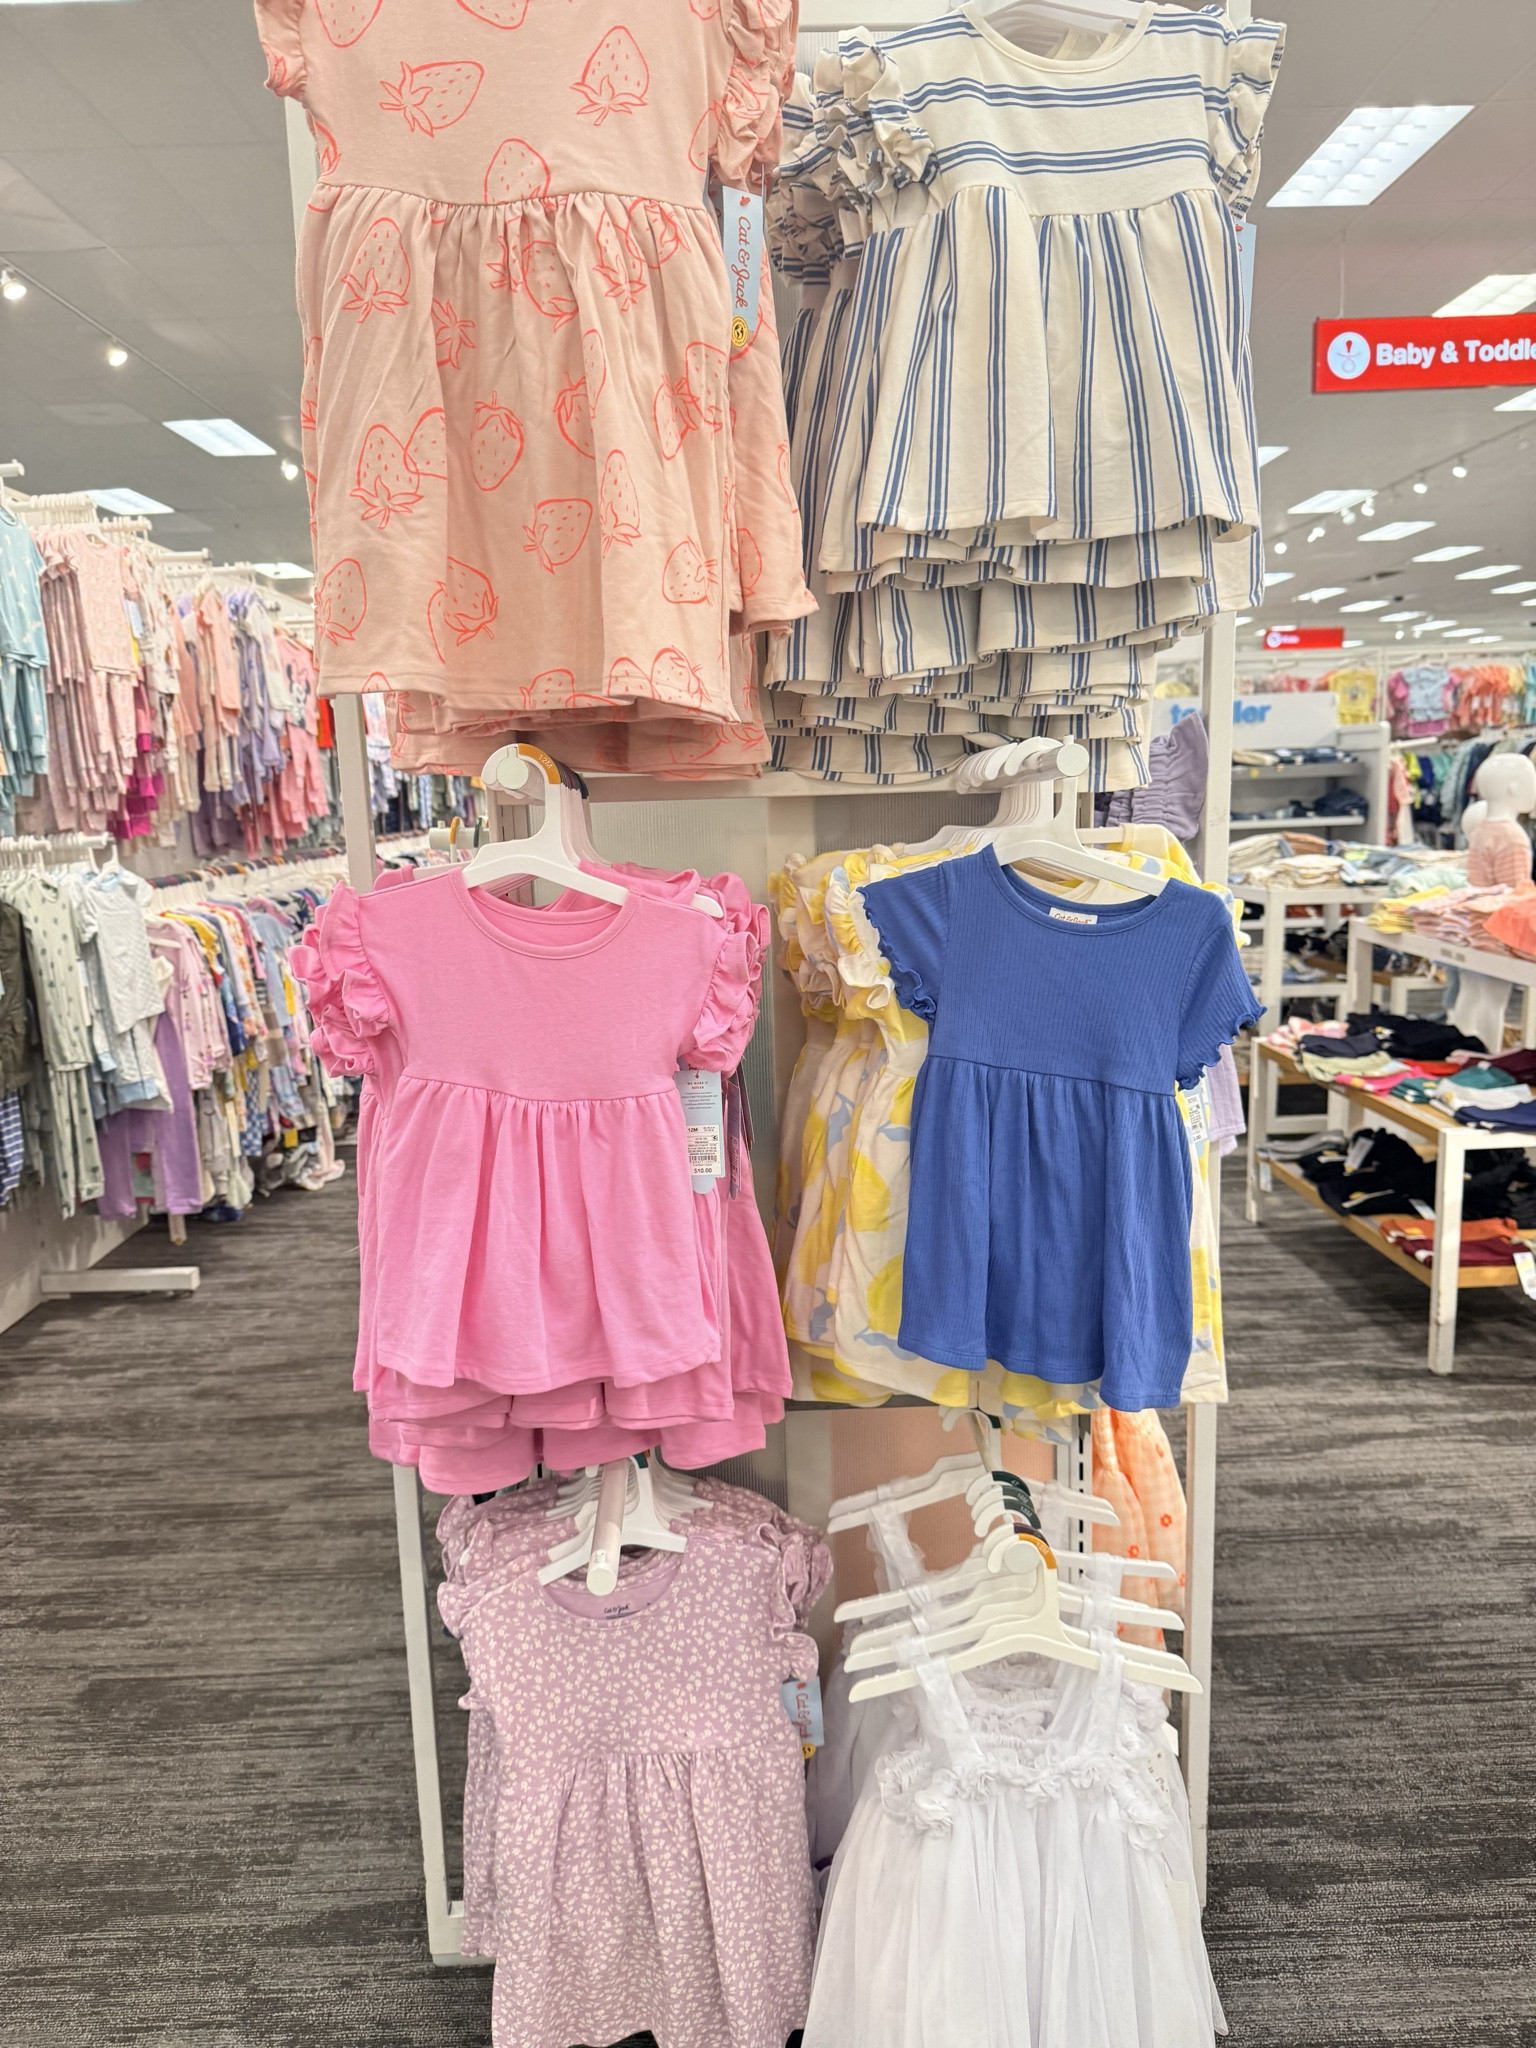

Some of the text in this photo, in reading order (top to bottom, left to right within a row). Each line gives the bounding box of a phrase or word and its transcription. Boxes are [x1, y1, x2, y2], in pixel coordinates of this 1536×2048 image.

[738, 215, 752, 246] Cat
[737, 247, 751, 267] &
[731, 264, 751, 309] Jack
[1376, 341, 1437, 369] Baby
[1440, 339, 1460, 364] &
[538, 754, 554, 770] 12M
